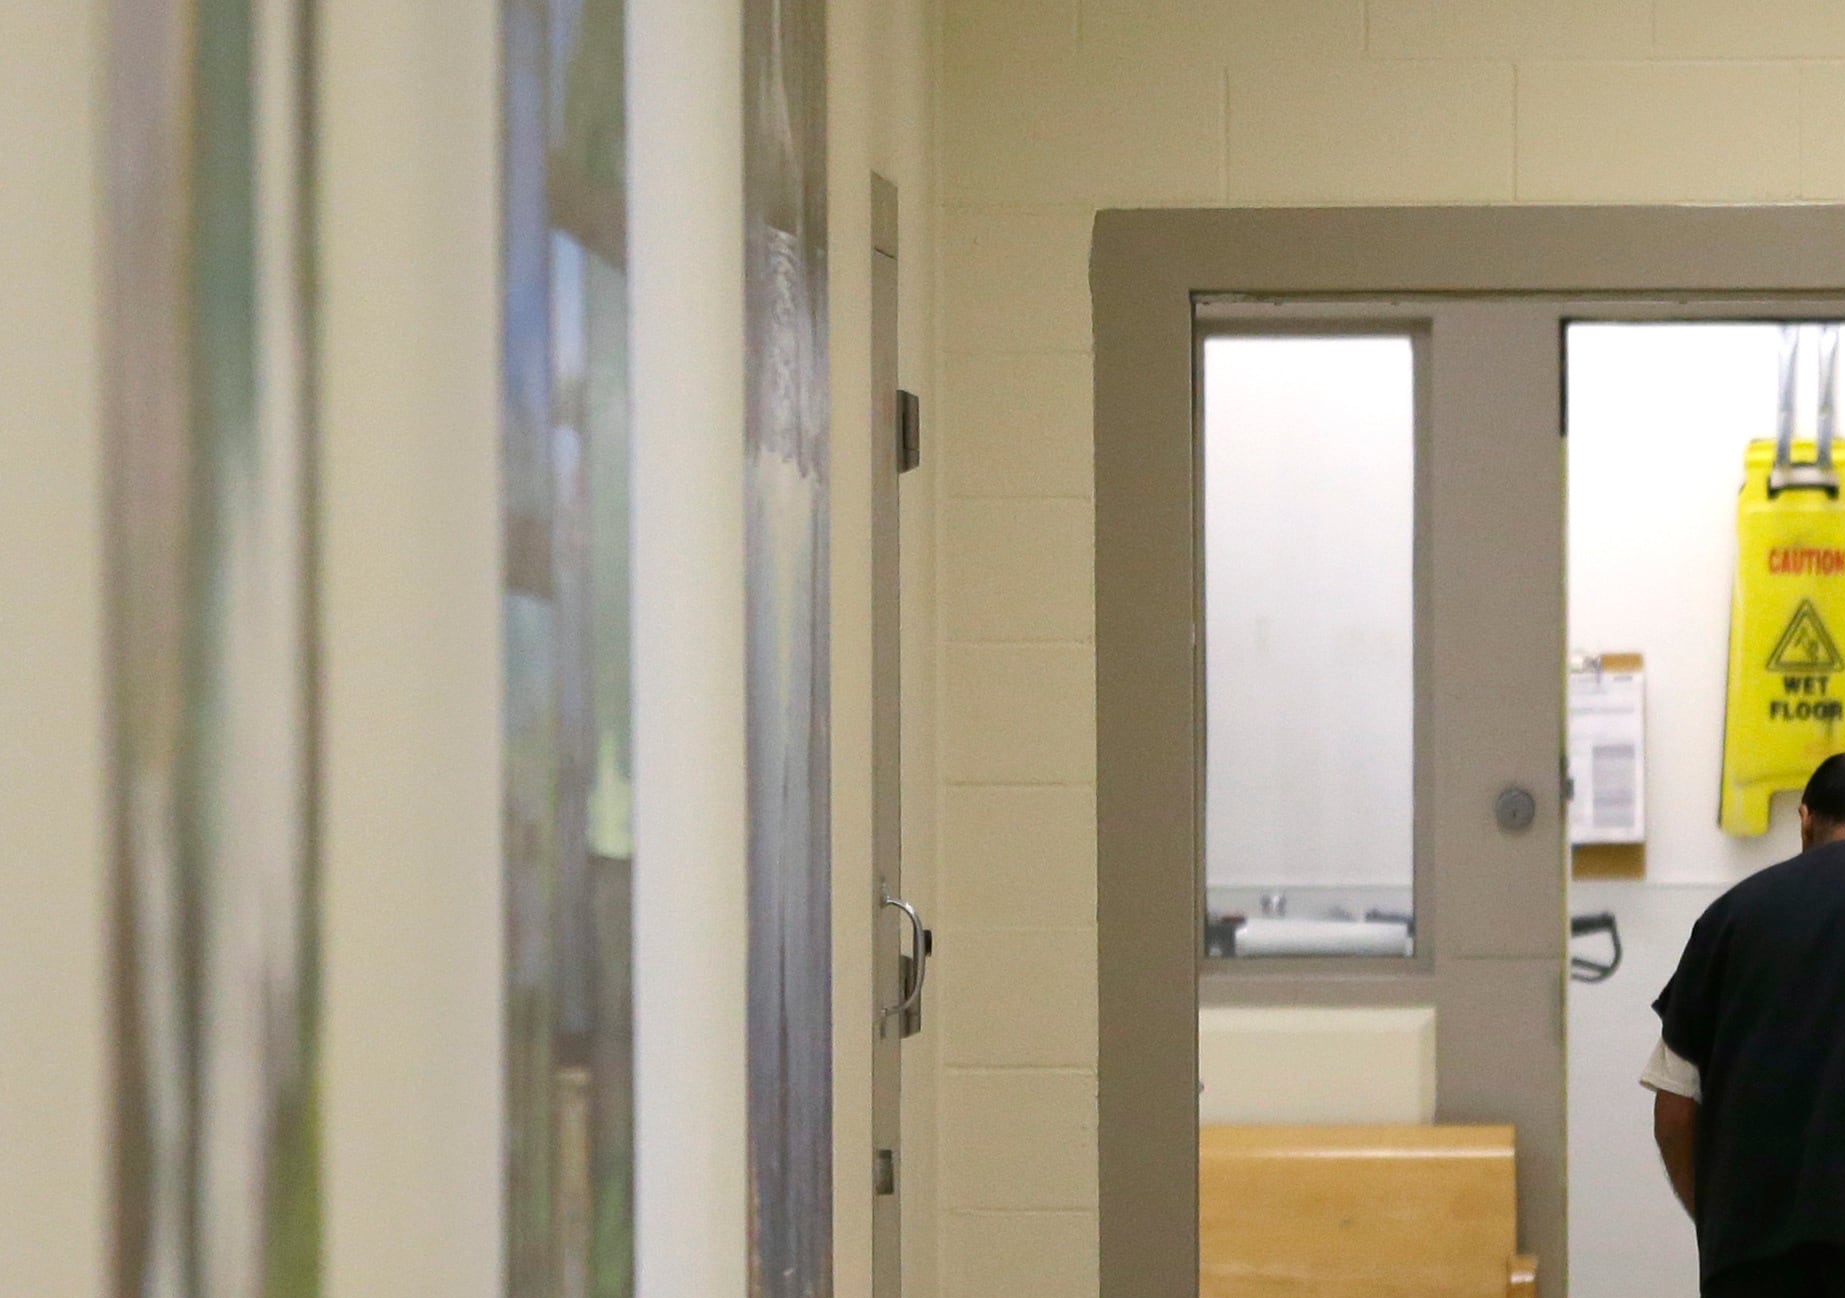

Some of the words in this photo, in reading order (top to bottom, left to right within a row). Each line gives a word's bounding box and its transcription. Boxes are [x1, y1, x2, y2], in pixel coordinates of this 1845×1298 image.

[1768, 549, 1845, 575] CAUTION
[1783, 676, 1829, 695] WET
[1770, 701, 1842, 721] FLOOR
